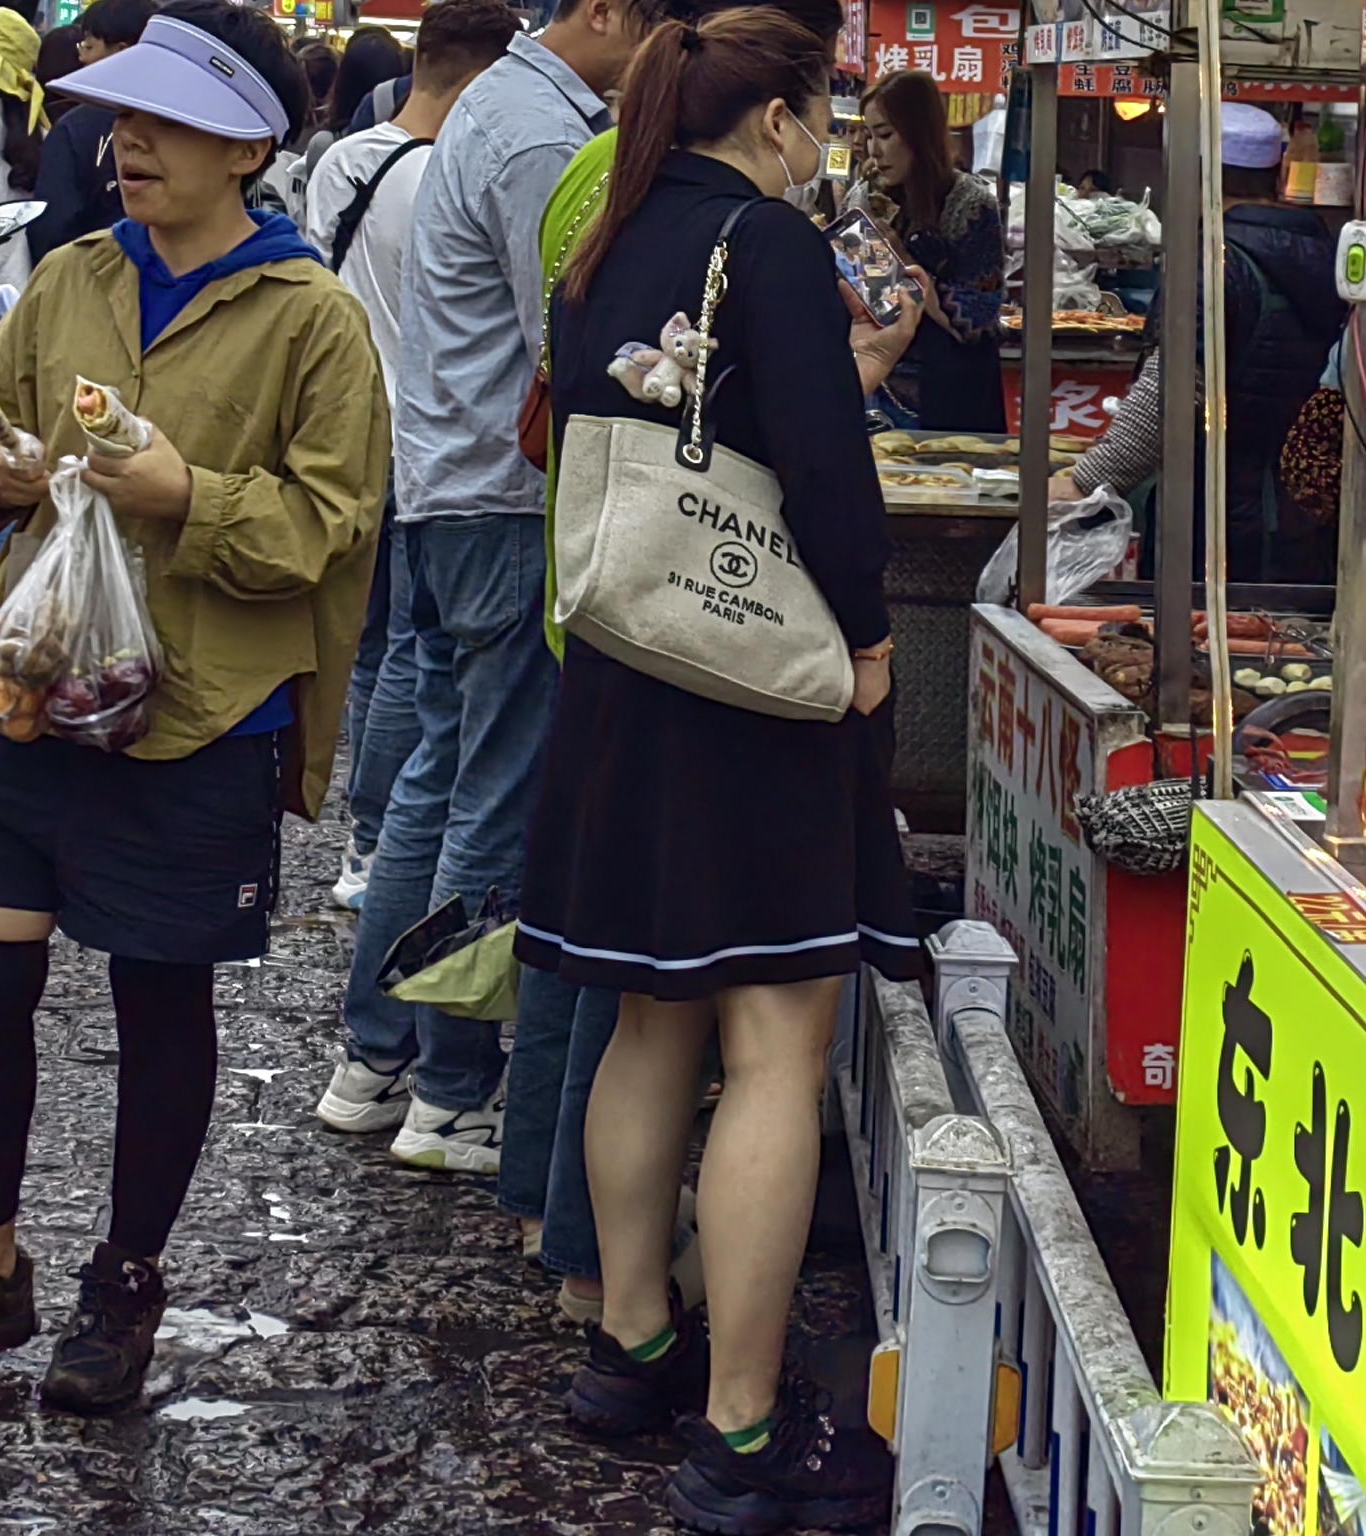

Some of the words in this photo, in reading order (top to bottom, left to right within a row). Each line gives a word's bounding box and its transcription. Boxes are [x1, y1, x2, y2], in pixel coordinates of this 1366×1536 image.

[874, 43, 984, 83] 烤乳扇
[677, 491, 800, 568] CHANEL
[667, 570, 683, 589] 31
[684, 576, 717, 601] RUE
[719, 589, 785, 627] CAMBON
[701, 599, 746, 626] PARIS
[1142, 1043, 1176, 1090] 奇
